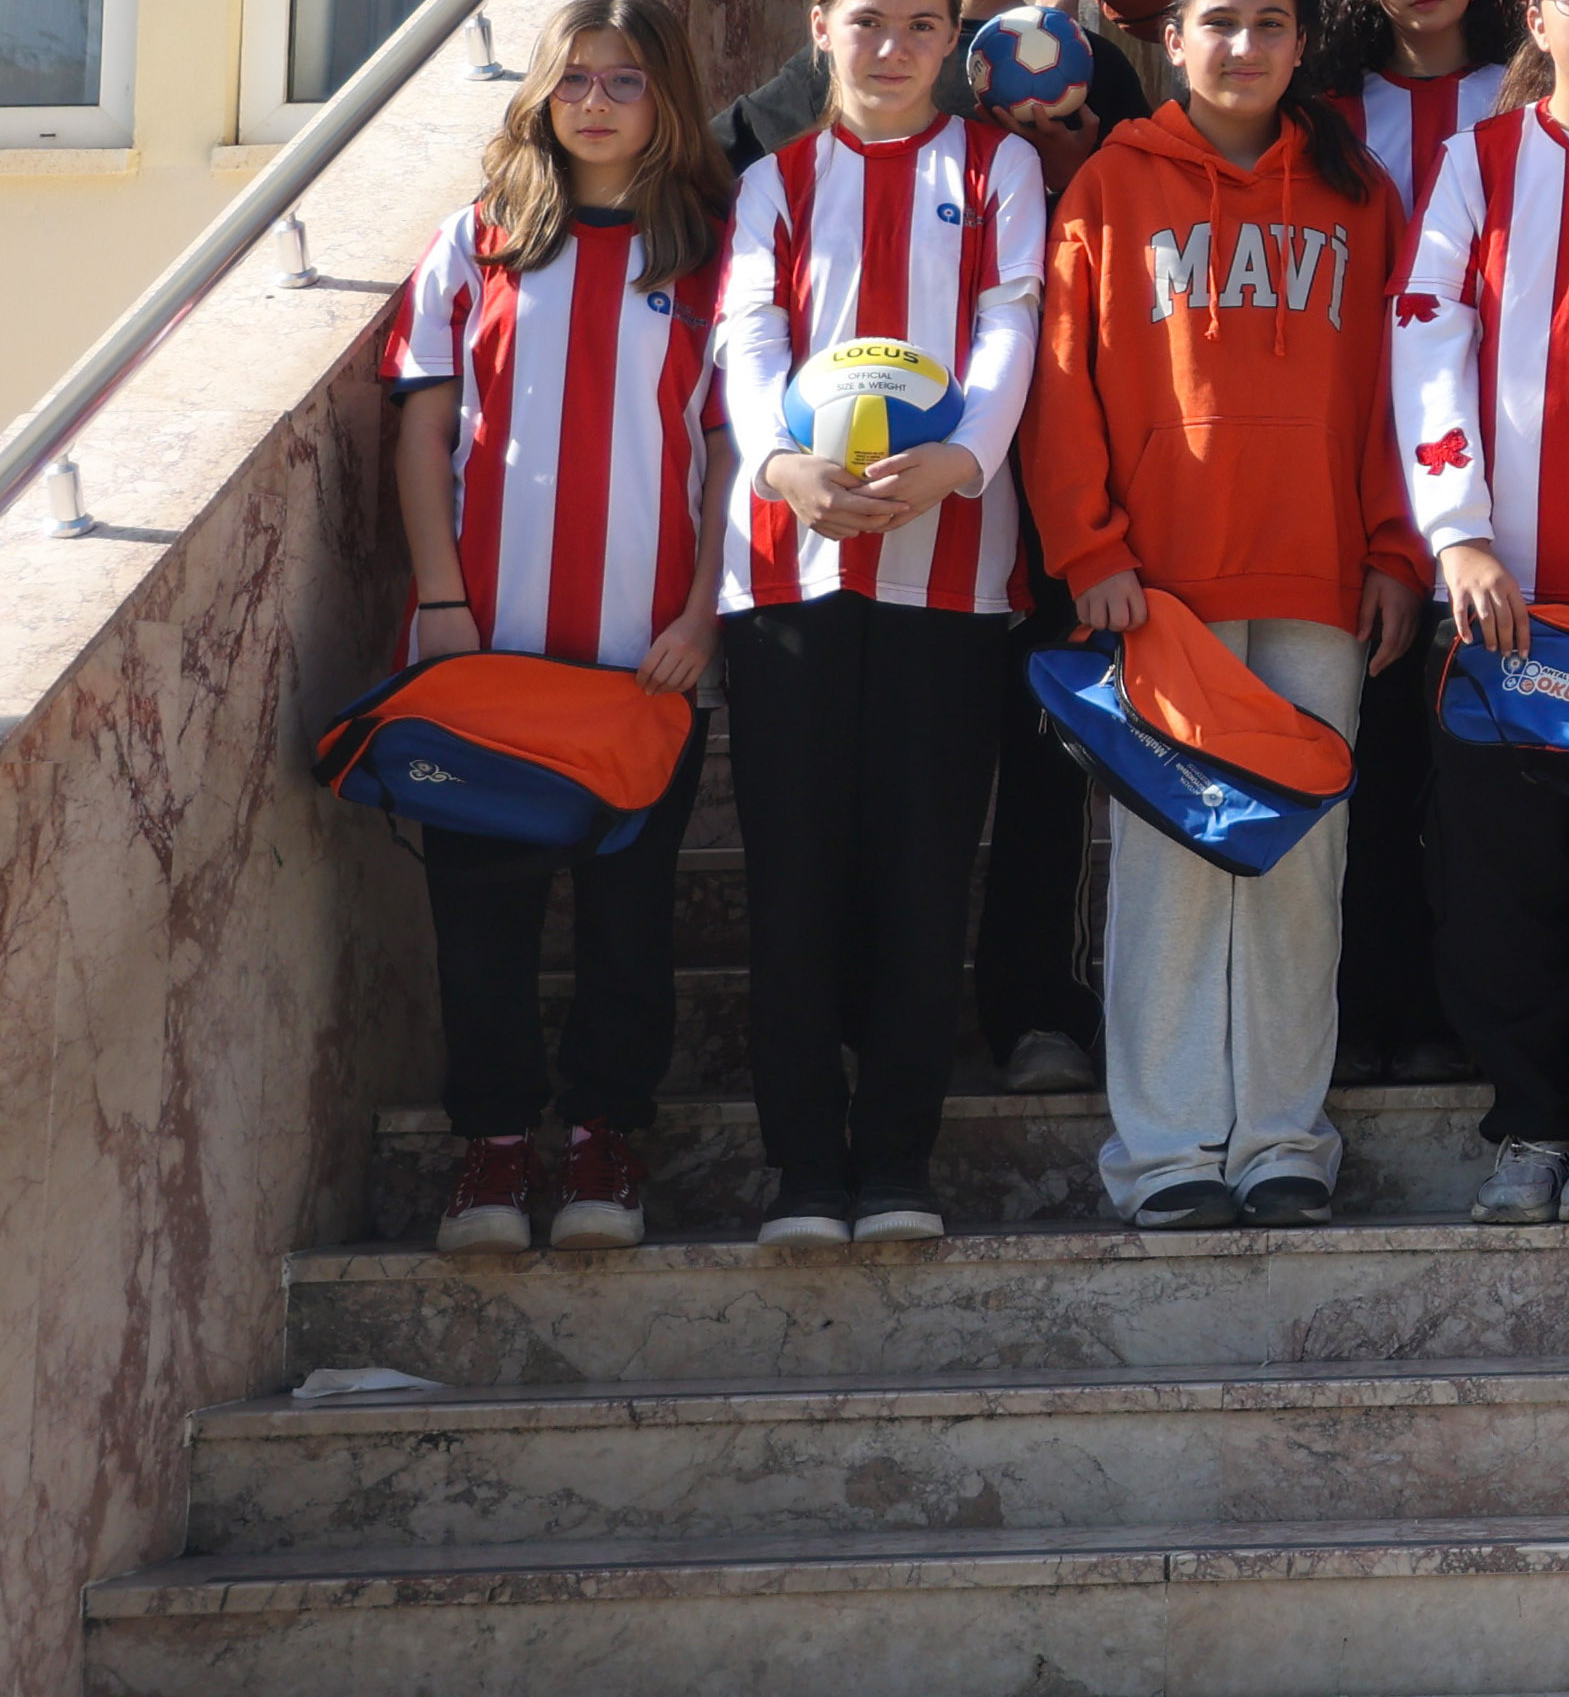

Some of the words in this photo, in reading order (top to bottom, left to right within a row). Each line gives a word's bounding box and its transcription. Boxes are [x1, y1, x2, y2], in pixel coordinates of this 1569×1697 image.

[1150, 220, 1349, 333] MAVİ
[833, 345, 920, 365] LOCUS
[847, 370, 893, 381] OFFICIAL
[836, 382, 854, 392] SIZE
[868, 380, 907, 393] WEIGHT
